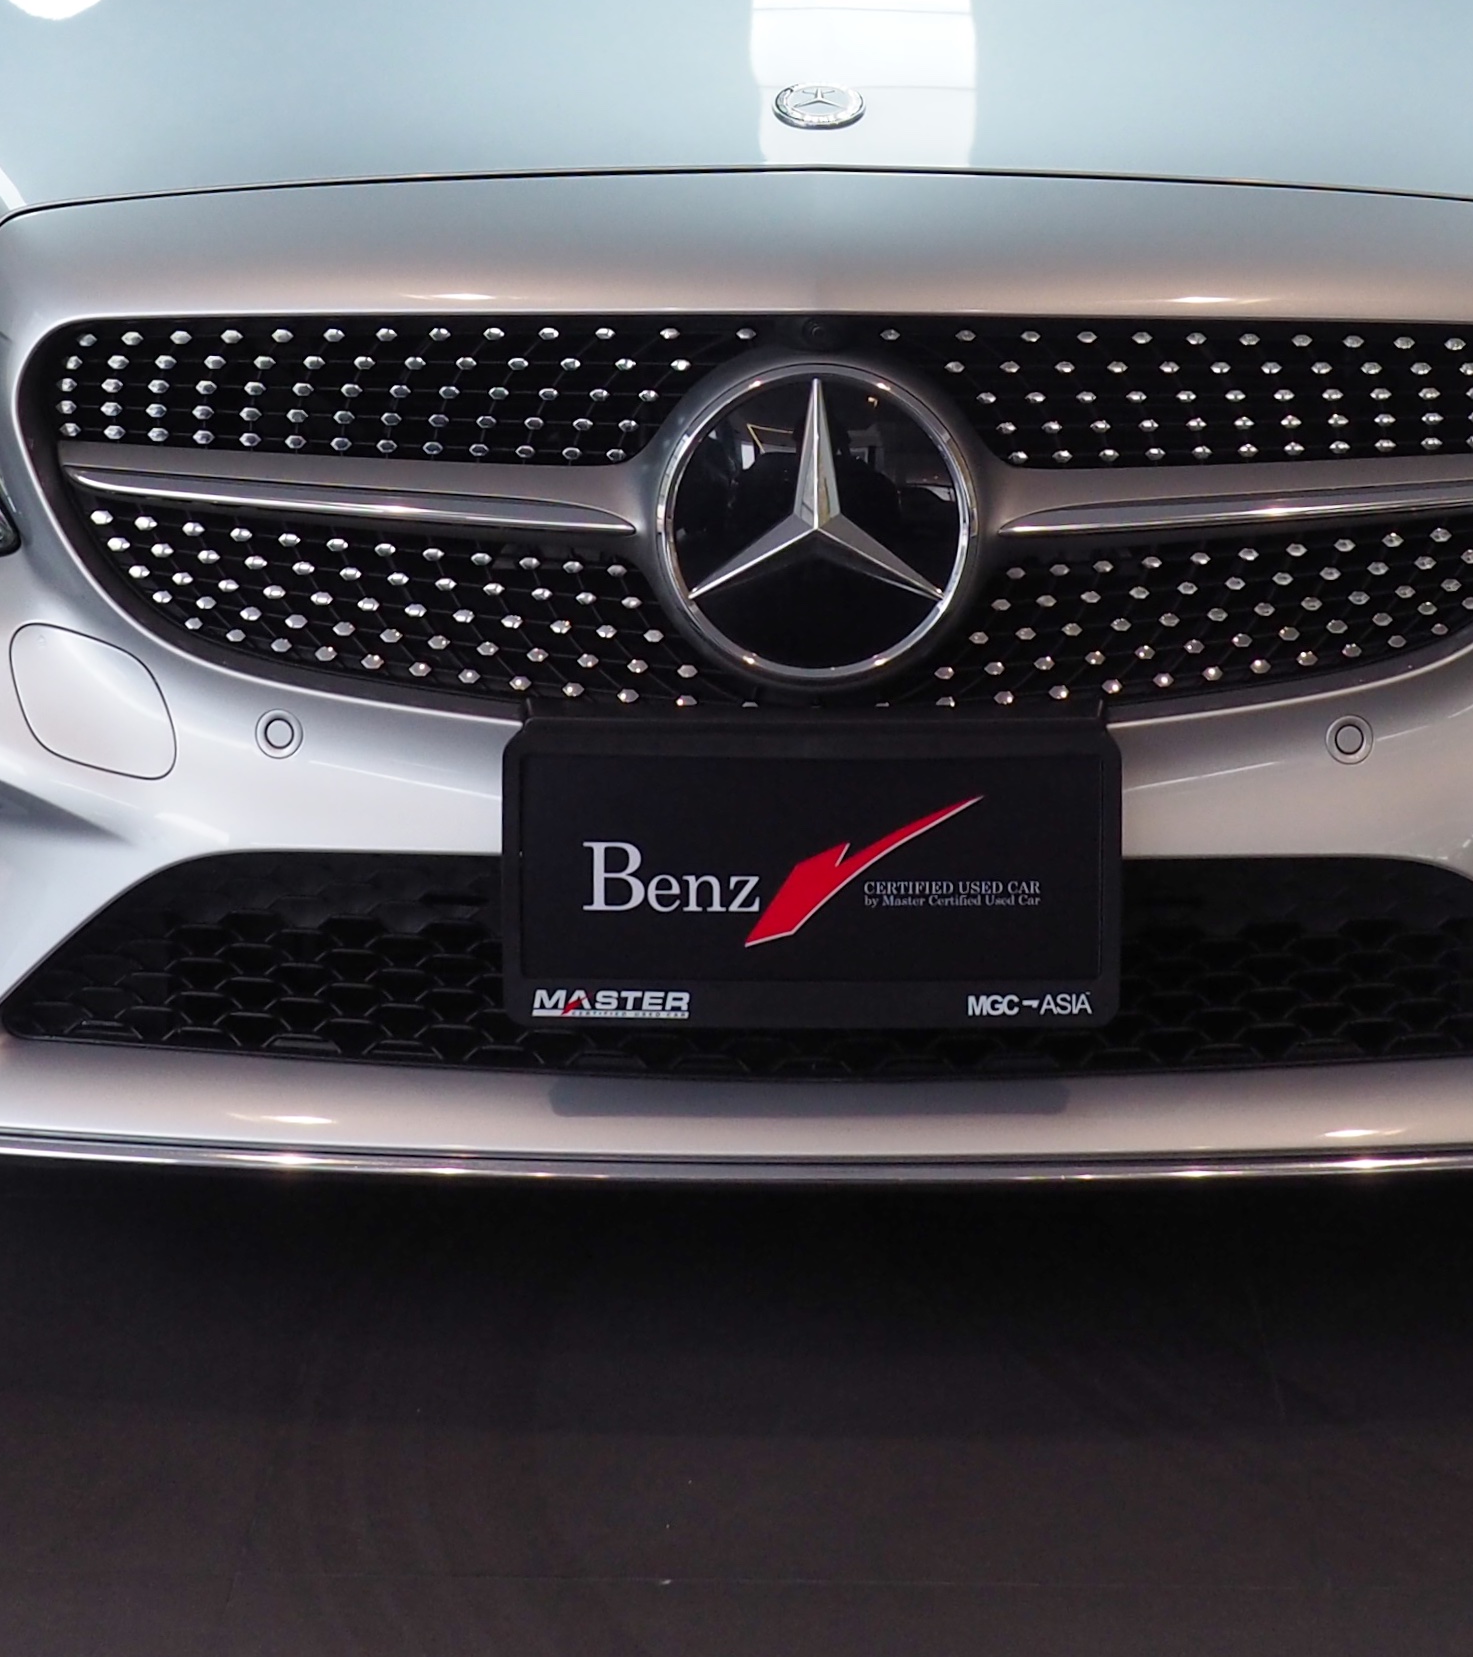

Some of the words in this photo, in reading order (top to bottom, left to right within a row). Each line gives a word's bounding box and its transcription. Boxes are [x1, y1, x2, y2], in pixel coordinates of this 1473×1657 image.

[581, 840, 761, 913] Benz
[863, 880, 954, 895] CERTIFIED
[958, 880, 1004, 895] USED
[1007, 880, 1041, 895] CAR
[864, 894, 879, 908] by
[882, 894, 926, 907] Master
[928, 894, 982, 907] Certified
[985, 894, 1015, 907] Used
[1018, 894, 1041, 906] Car
[533, 989, 690, 1011] MASTER
